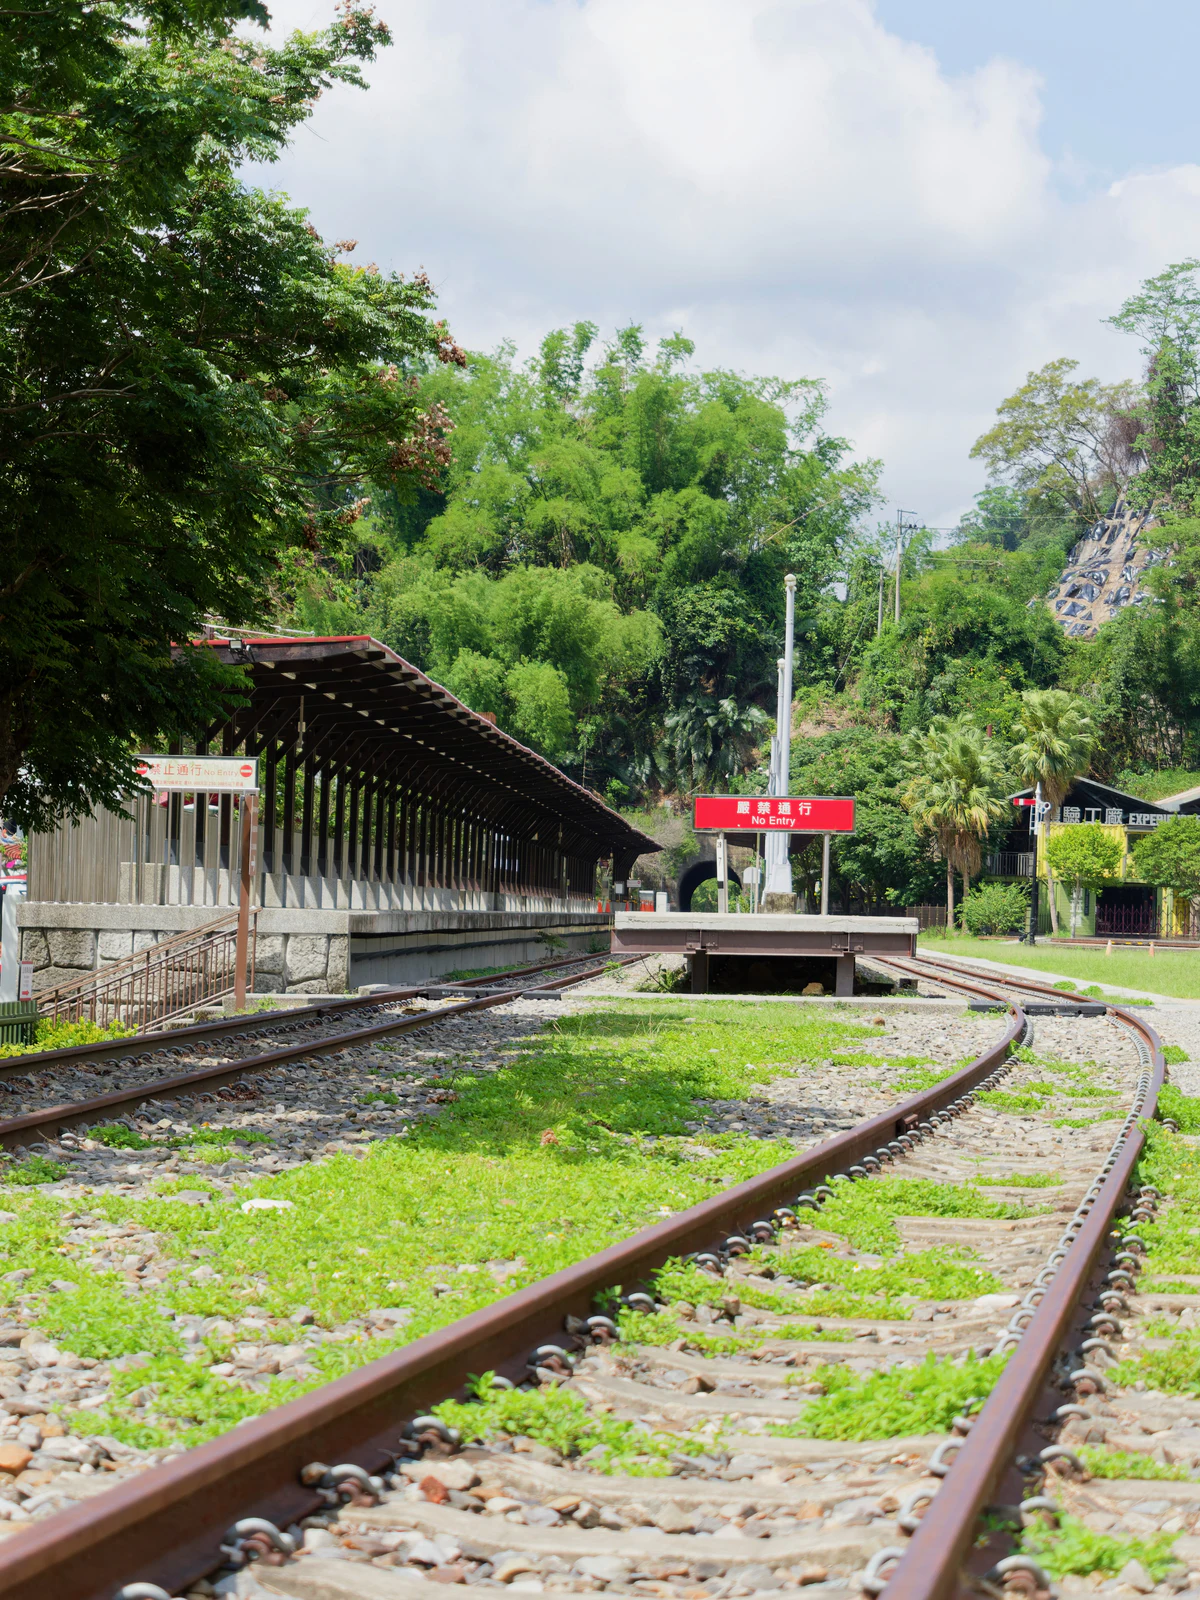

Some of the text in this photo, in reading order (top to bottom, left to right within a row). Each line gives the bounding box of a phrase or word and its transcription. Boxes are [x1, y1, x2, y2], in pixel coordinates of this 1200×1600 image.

[150, 763, 202, 776] 禁止通行
[217, 769, 238, 778] Entry
[737, 801, 812, 816] 嚴禁通行
[751, 816, 796, 827] No Entry
